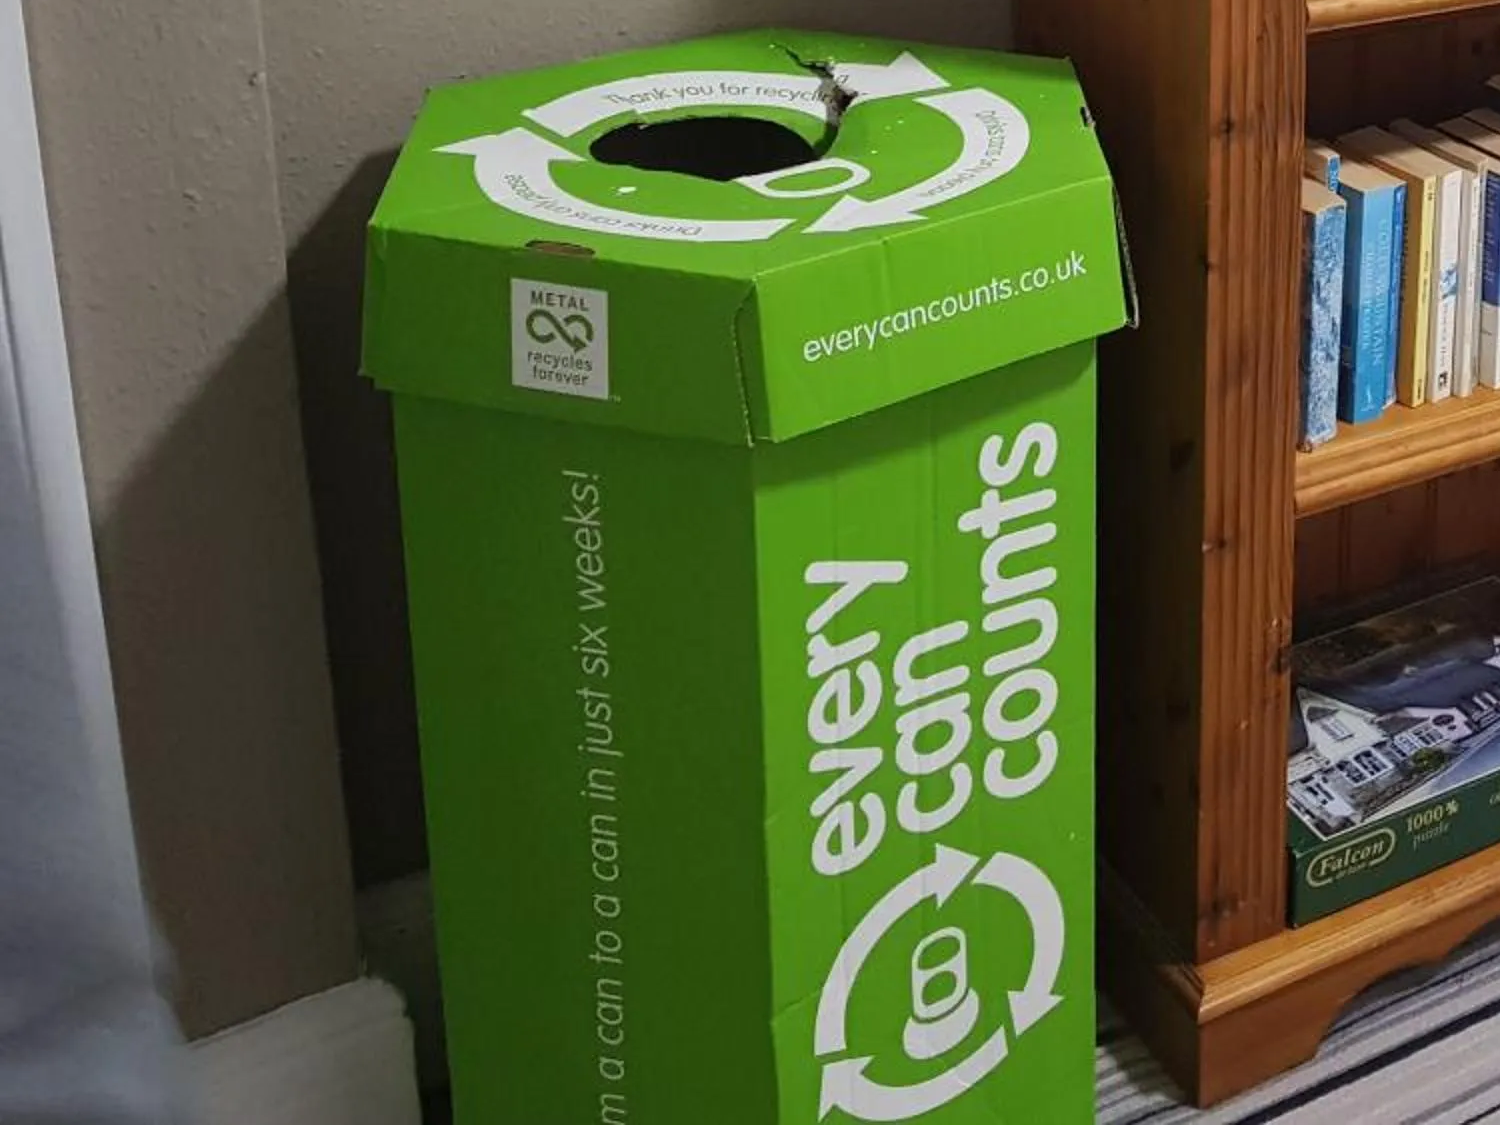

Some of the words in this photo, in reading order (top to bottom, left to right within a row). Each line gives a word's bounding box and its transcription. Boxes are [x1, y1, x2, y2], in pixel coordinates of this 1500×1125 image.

[603, 86, 671, 106] Thank
[672, 83, 714, 100] you
[719, 82, 750, 97] for
[530, 289, 590, 313] METAL
[803, 250, 1087, 363] everycancounts.co.uk
[527, 348, 594, 375] recycles
[532, 364, 590, 387] forever
[562, 469, 605, 613] weeks!
[957, 421, 1059, 799] counts
[572, 625, 610, 678] six
[576, 688, 624, 759] just
[804, 560, 909, 876] every
[892, 620, 973, 833] can
[580, 773, 615, 805] in
[1406, 806, 1444, 833] 1000
[587, 813, 620, 882] can
[1319, 840, 1385, 877] Falcon
[592, 887, 622, 919] a
[588, 929, 624, 968] to
[595, 977, 625, 1047] can
[599, 1057, 625, 1081] a
